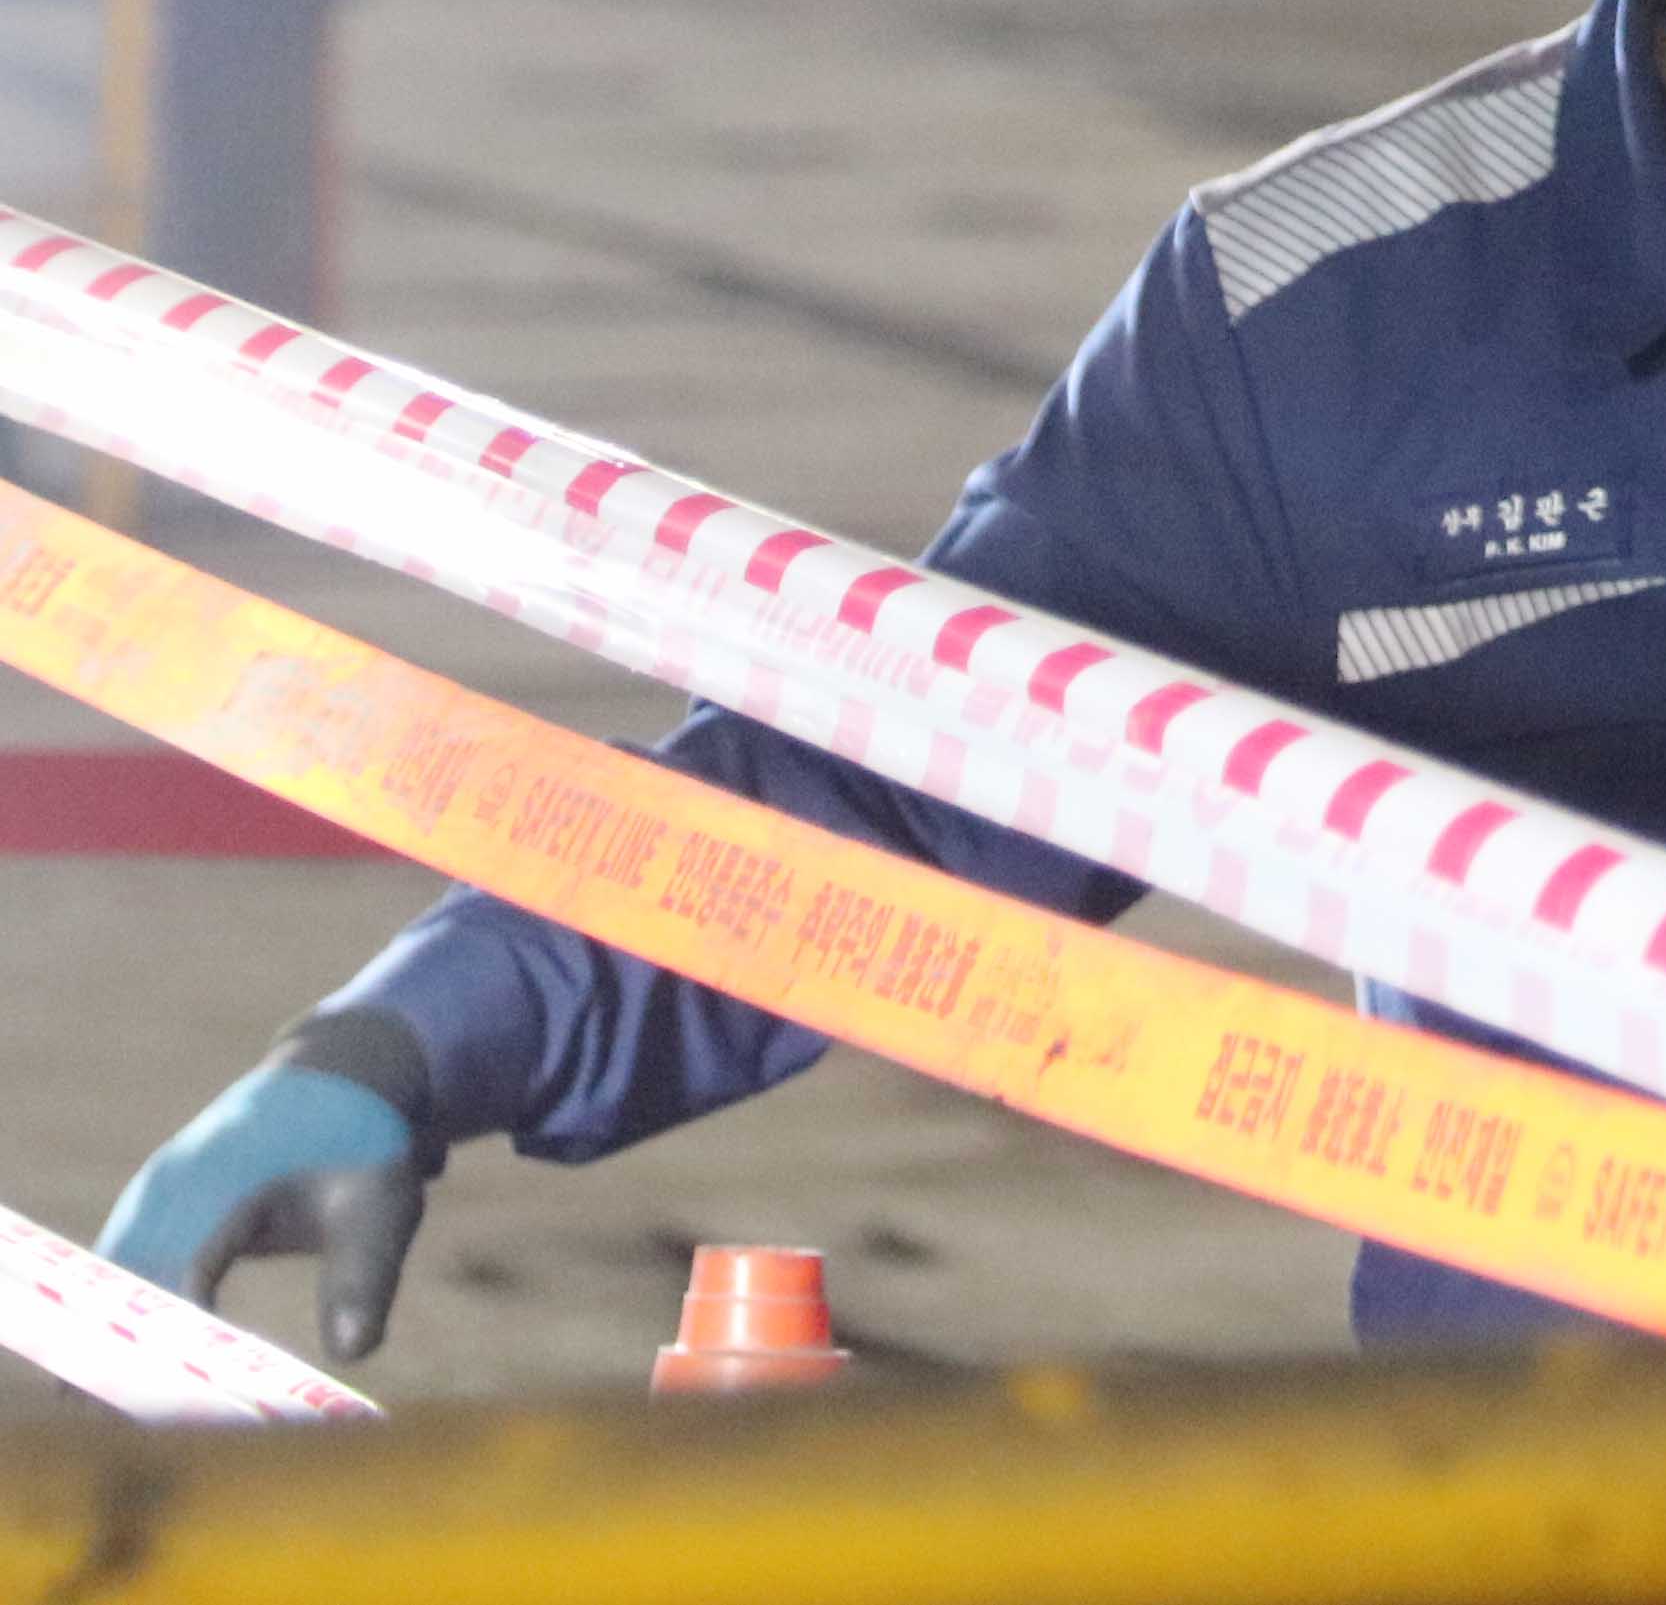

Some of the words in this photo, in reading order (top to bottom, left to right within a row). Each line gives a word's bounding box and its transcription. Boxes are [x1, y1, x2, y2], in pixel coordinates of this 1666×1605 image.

[509, 776, 613, 865] SAFETY
[594, 807, 669, 889] LINE
[1195, 1031, 1306, 1144] 접근금지
